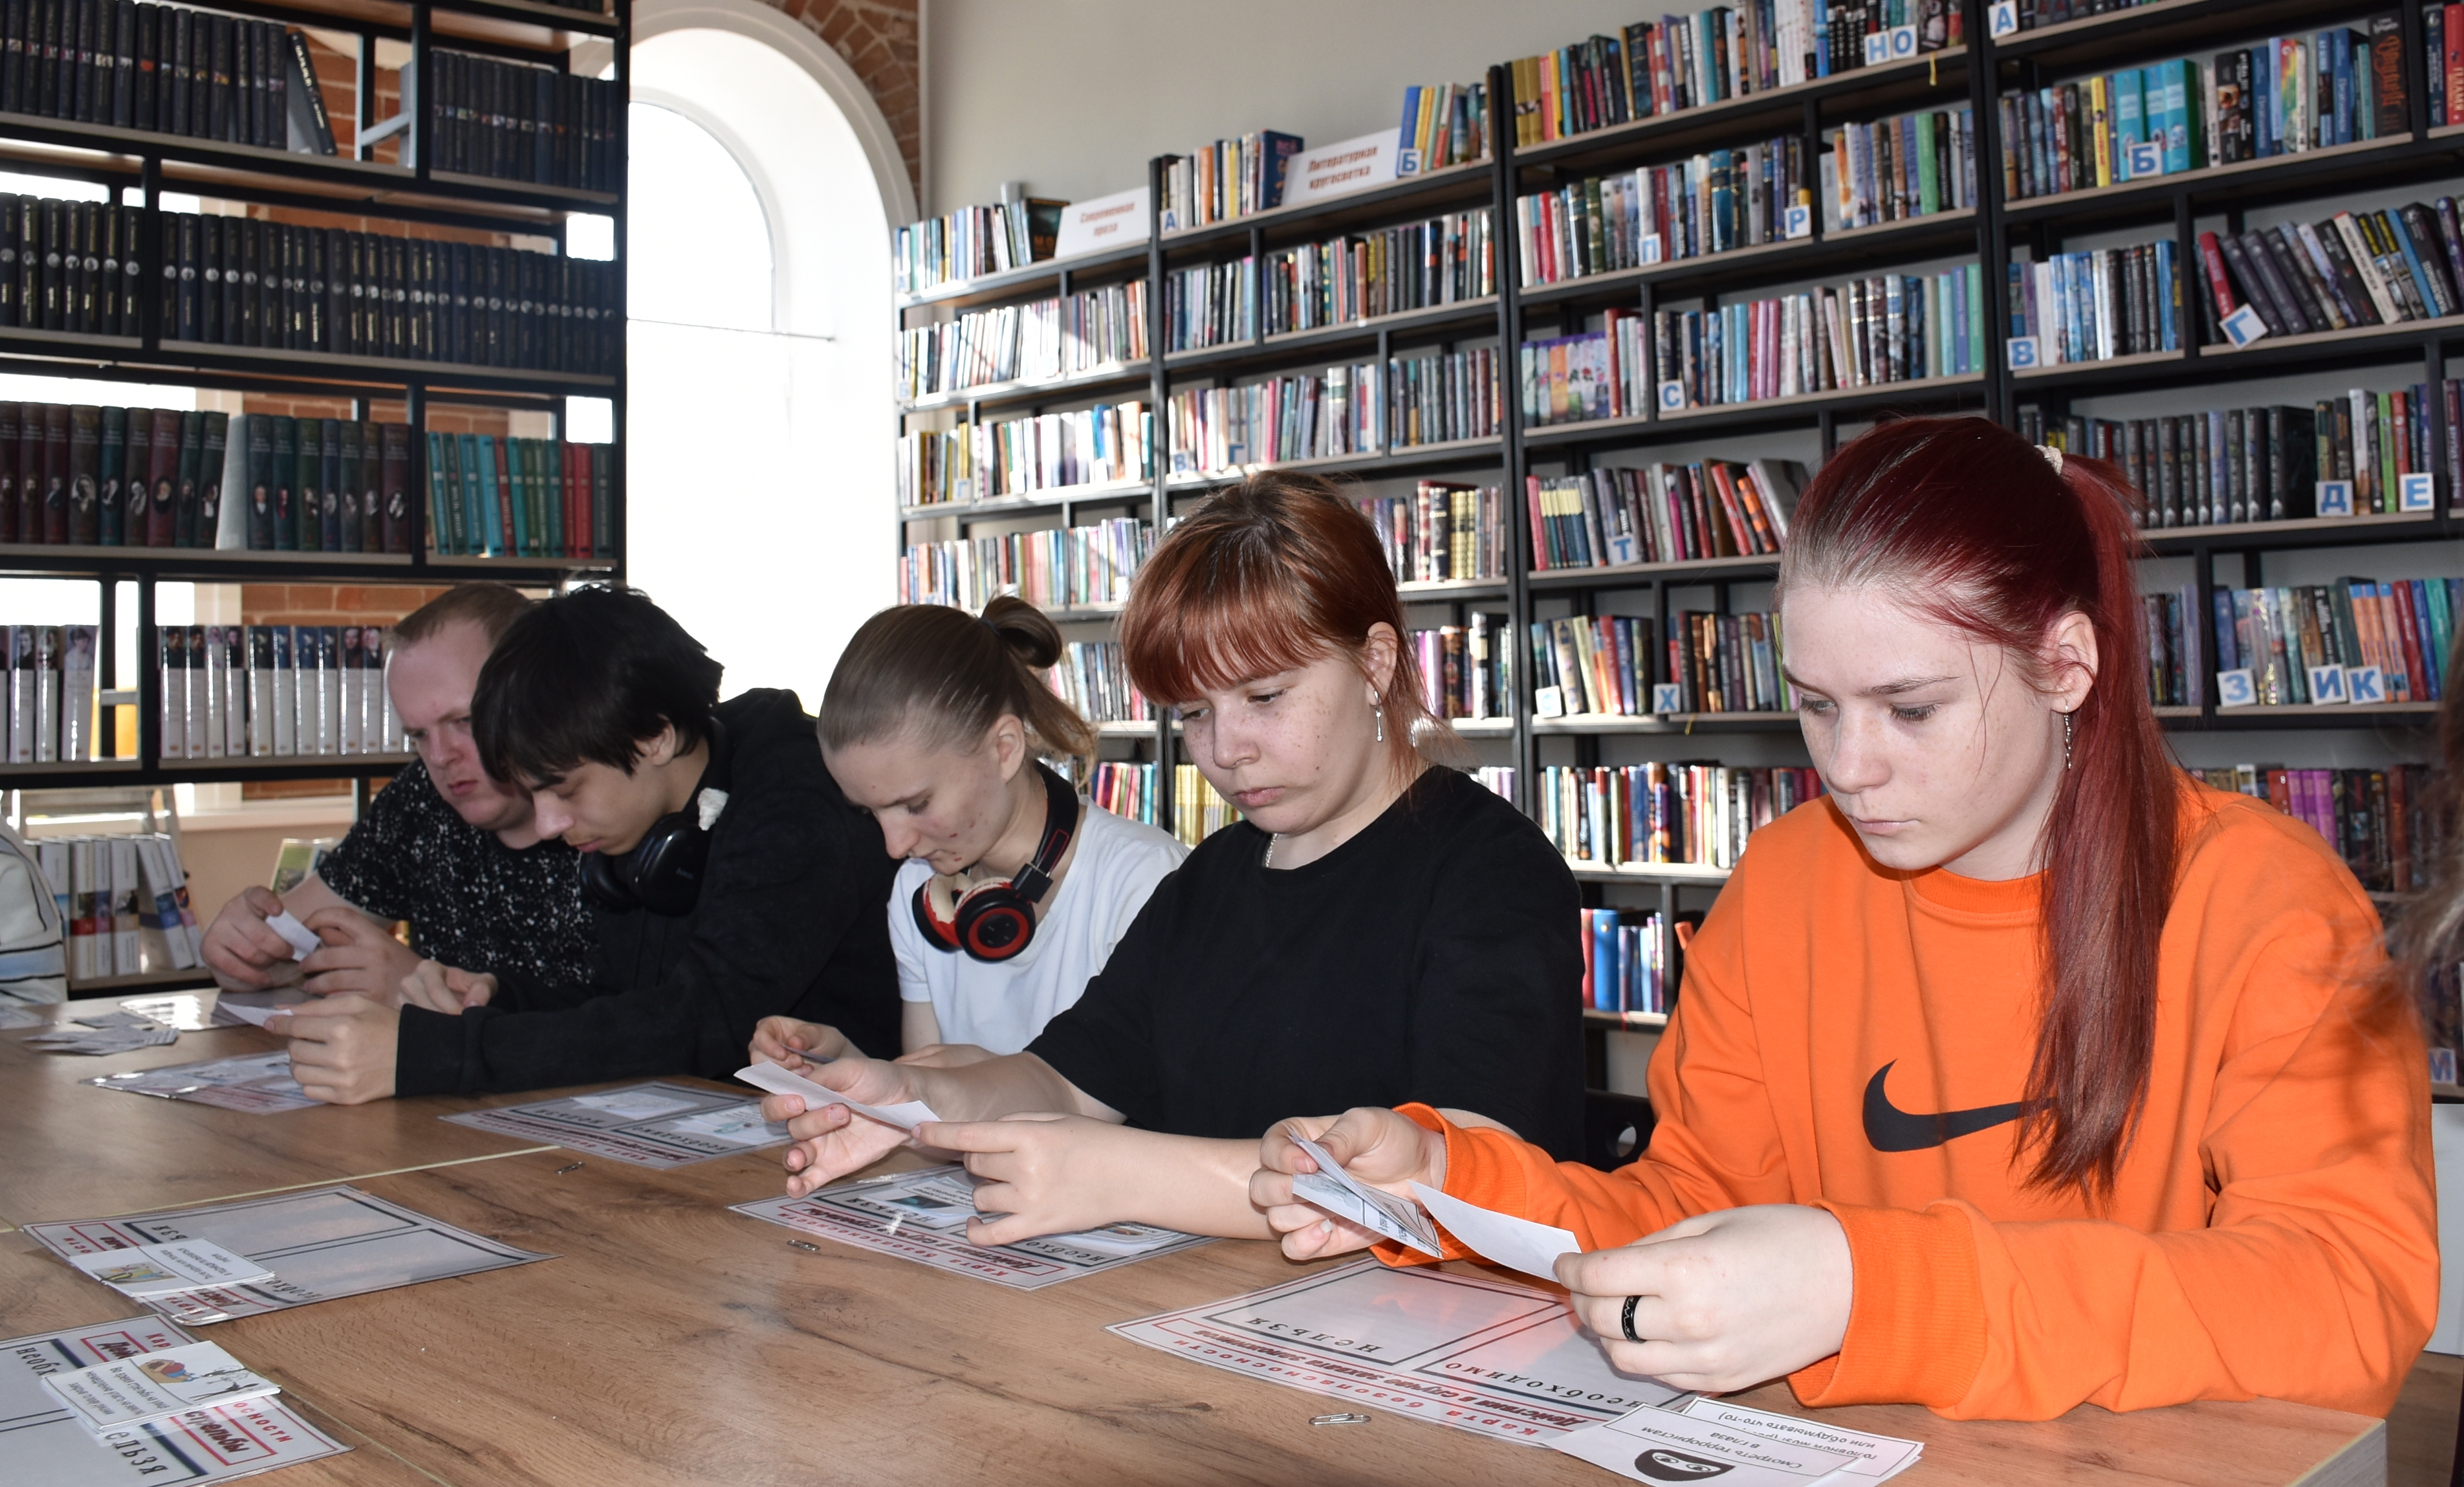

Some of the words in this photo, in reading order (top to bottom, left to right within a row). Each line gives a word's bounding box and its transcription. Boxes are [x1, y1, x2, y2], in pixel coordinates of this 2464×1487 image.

[1996, 6, 2014, 32] А
[1868, 36, 1888, 61] Н
[1893, 30, 1913, 54] О
[1309, 146, 1379, 173] Литературная
[1402, 152, 1417, 171] Б
[2132, 146, 2157, 173] Б
[1309, 165, 1371, 190] кругосветка
[1164, 212, 1177, 230] А
[1789, 208, 1807, 233] Р
[1642, 238, 1658, 262] П
[2011, 340, 2035, 366] В
[1663, 384, 1681, 407] С
[2321, 484, 2348, 512] Д
[2406, 477, 2430, 507] Е
[1613, 538, 1632, 561] Т
[2226, 674, 2250, 701] З
[2315, 669, 2342, 699] И
[2351, 670, 2379, 701] К
[1660, 689, 1676, 710] Х
[151, 1225, 188, 1241] ьзя
[778, 1213, 937, 1258] безопасности
[1027, 1241, 1107, 1262] необхо
[949, 1259, 1009, 1277] Карта
[146, 1333, 174, 1349] Кар
[1245, 1317, 1384, 1353] нельзя
[16, 1347, 61, 1376] необх
[1173, 1339, 1424, 1408] безопасности
[1305, 1360, 1384, 1380] захвата
[1445, 1363, 1648, 1408] необходимо
[1446, 1411, 1540, 1435] Карта
[1475, 1400, 1589, 1426] Действия
[1717, 1412, 1765, 1428] что-то)
[1641, 1426, 1731, 1455] террористам
[1710, 1431, 1749, 1448] глаза
[1765, 1421, 1848, 1444] обдумывать
[1850, 1439, 1875, 1450] или
[104, 1431, 169, 1475] ельзя
[1734, 1448, 1803, 1470] Смотреть
